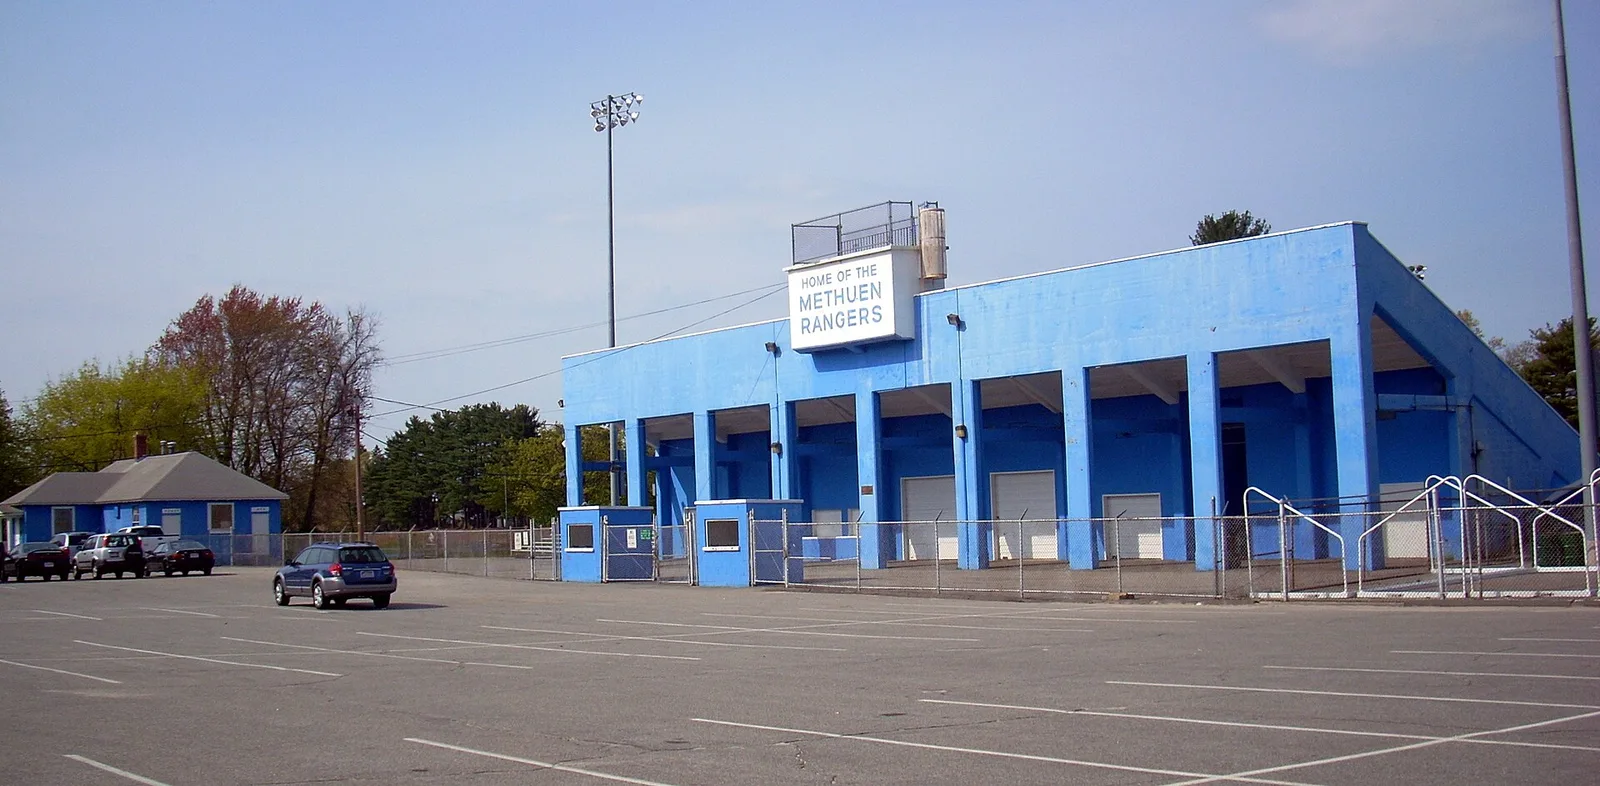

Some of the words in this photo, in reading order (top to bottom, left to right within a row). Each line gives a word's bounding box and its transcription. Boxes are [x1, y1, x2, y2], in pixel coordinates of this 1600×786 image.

[802, 273, 832, 289] HOME
[837, 269, 851, 282] OF
[856, 264, 877, 278] THE
[800, 281, 881, 312] METHUEN
[801, 305, 882, 334] RANGERS
